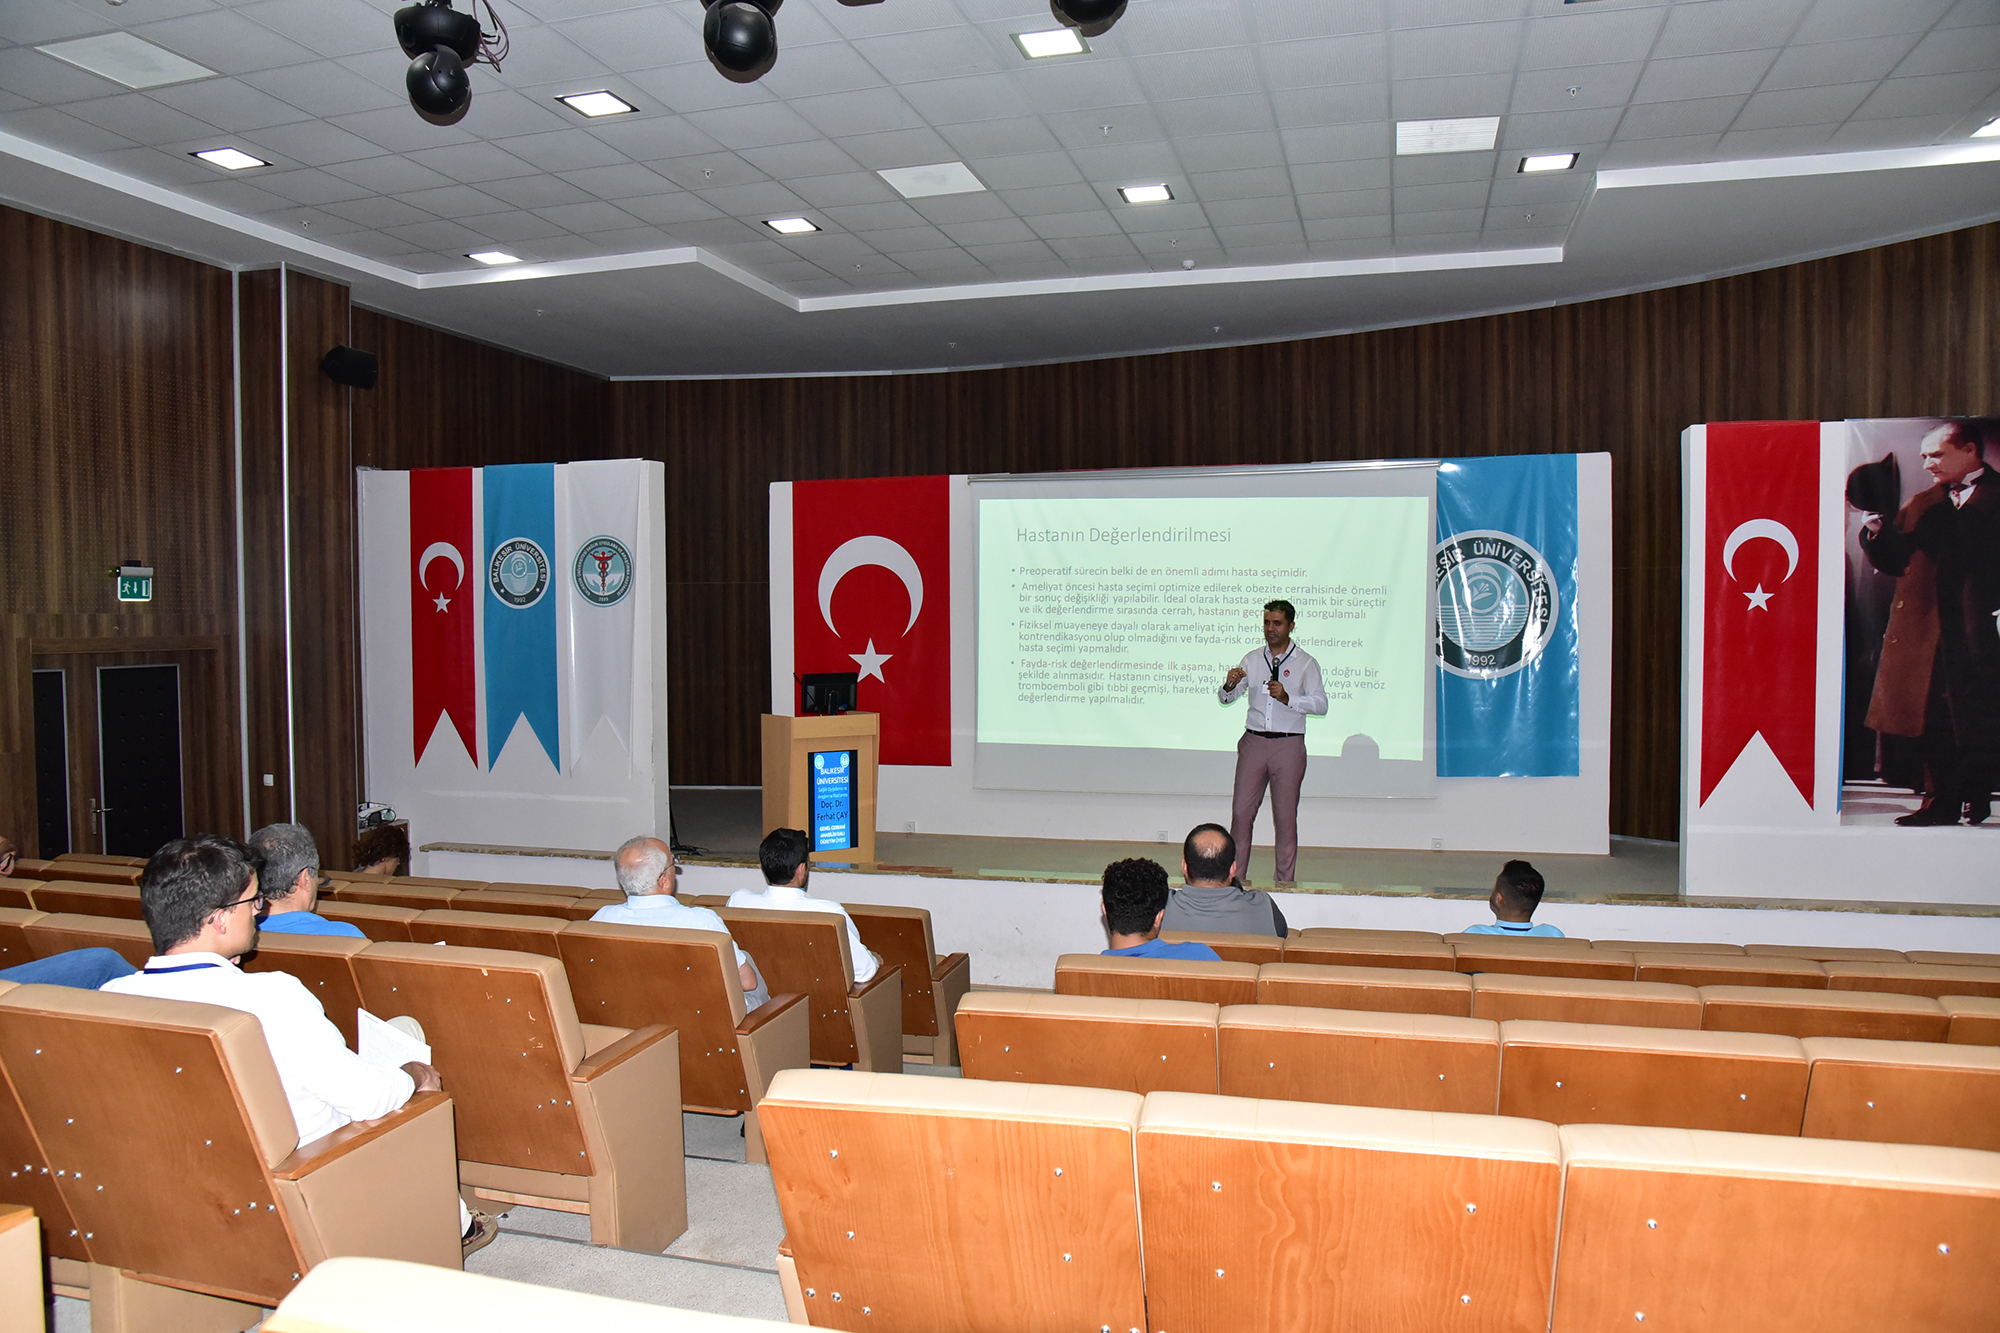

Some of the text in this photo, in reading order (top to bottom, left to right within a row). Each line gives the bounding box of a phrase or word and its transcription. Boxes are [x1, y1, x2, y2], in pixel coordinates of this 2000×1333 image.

[1017, 527, 1231, 545] Hastanın Değerlendirilmesi
[1019, 566, 1072, 577] Preoperatif
[1074, 567, 1108, 576] sürecin
[1111, 567, 1133, 576] belki
[1136, 567, 1148, 576] de
[1166, 567, 1199, 576] önemli
[1202, 568, 1229, 577] adımı
[1231, 567, 1258, 577] hasta
[1261, 568, 1308, 579] seçimidir.
[1022, 582, 1387, 595] Ameliyat öncesi hasta seçimi optimize edilerek obezite cerrahisinde önemli
[1019, 593, 1031, 602] bir
[1034, 595, 1061, 605] sonuç
[1064, 594, 1109, 605] değişikliği
[1112, 595, 1160, 606] yapılabilir.
[1189, 595, 1220, 604] olarak
[1222, 595, 1249, 605] hasta
[1330, 597, 1344, 606] bir
[1347, 597, 1387, 608] süreçtir
[1033, 604, 1043, 613] ilk
[1045, 604, 1114, 615] değerlendirme
[1116, 605, 1158, 614] sırasında
[1161, 605, 1196, 616] cerrah,
[1198, 606, 1240, 616] hastanın
[1306, 608, 1366, 620] sorgulamalı
[1019, 620, 1052, 630] Fiziksel
[1054, 622, 1108, 632] muayeneye
[1111, 621, 1138, 631] dayalı
[1141, 622, 1171, 631] olarak
[1173, 622, 1215, 633] ameliyat
[1217, 623, 1235, 633] için
[1019, 632, 1101, 643] kontrendikasyonu
[1104, 632, 1125, 643] olup
[1194, 634, 1242, 645] fayda-risk
[1018, 642, 1043, 652] hasta
[1046, 643, 1075, 654] seçimi
[1021, 659, 1067, 669] Fayda-risk
[1070, 659, 1164, 671] değerlendirmesinde
[1167, 661, 1178, 670] ilk
[1331, 667, 1361, 678] doğru
[1364, 667, 1379, 677] bir
[1018, 669, 1050, 681] şekilde
[1109, 672, 1151, 681] Hastanın
[1153, 672, 1195, 683] cinsiyeti,
[1354, 680, 1386, 690] venöz
[1018, 682, 1085, 692] tromboemboli
[1087, 683, 1104, 693] gibi
[1172, 684, 1210, 694] hareket
[1018, 693, 1145, 705] değerlendirme yapılmalıdır.
[821, 799, 844, 810] Doç. Dr.
[817, 810, 848, 822] Ferhat ÇAY
